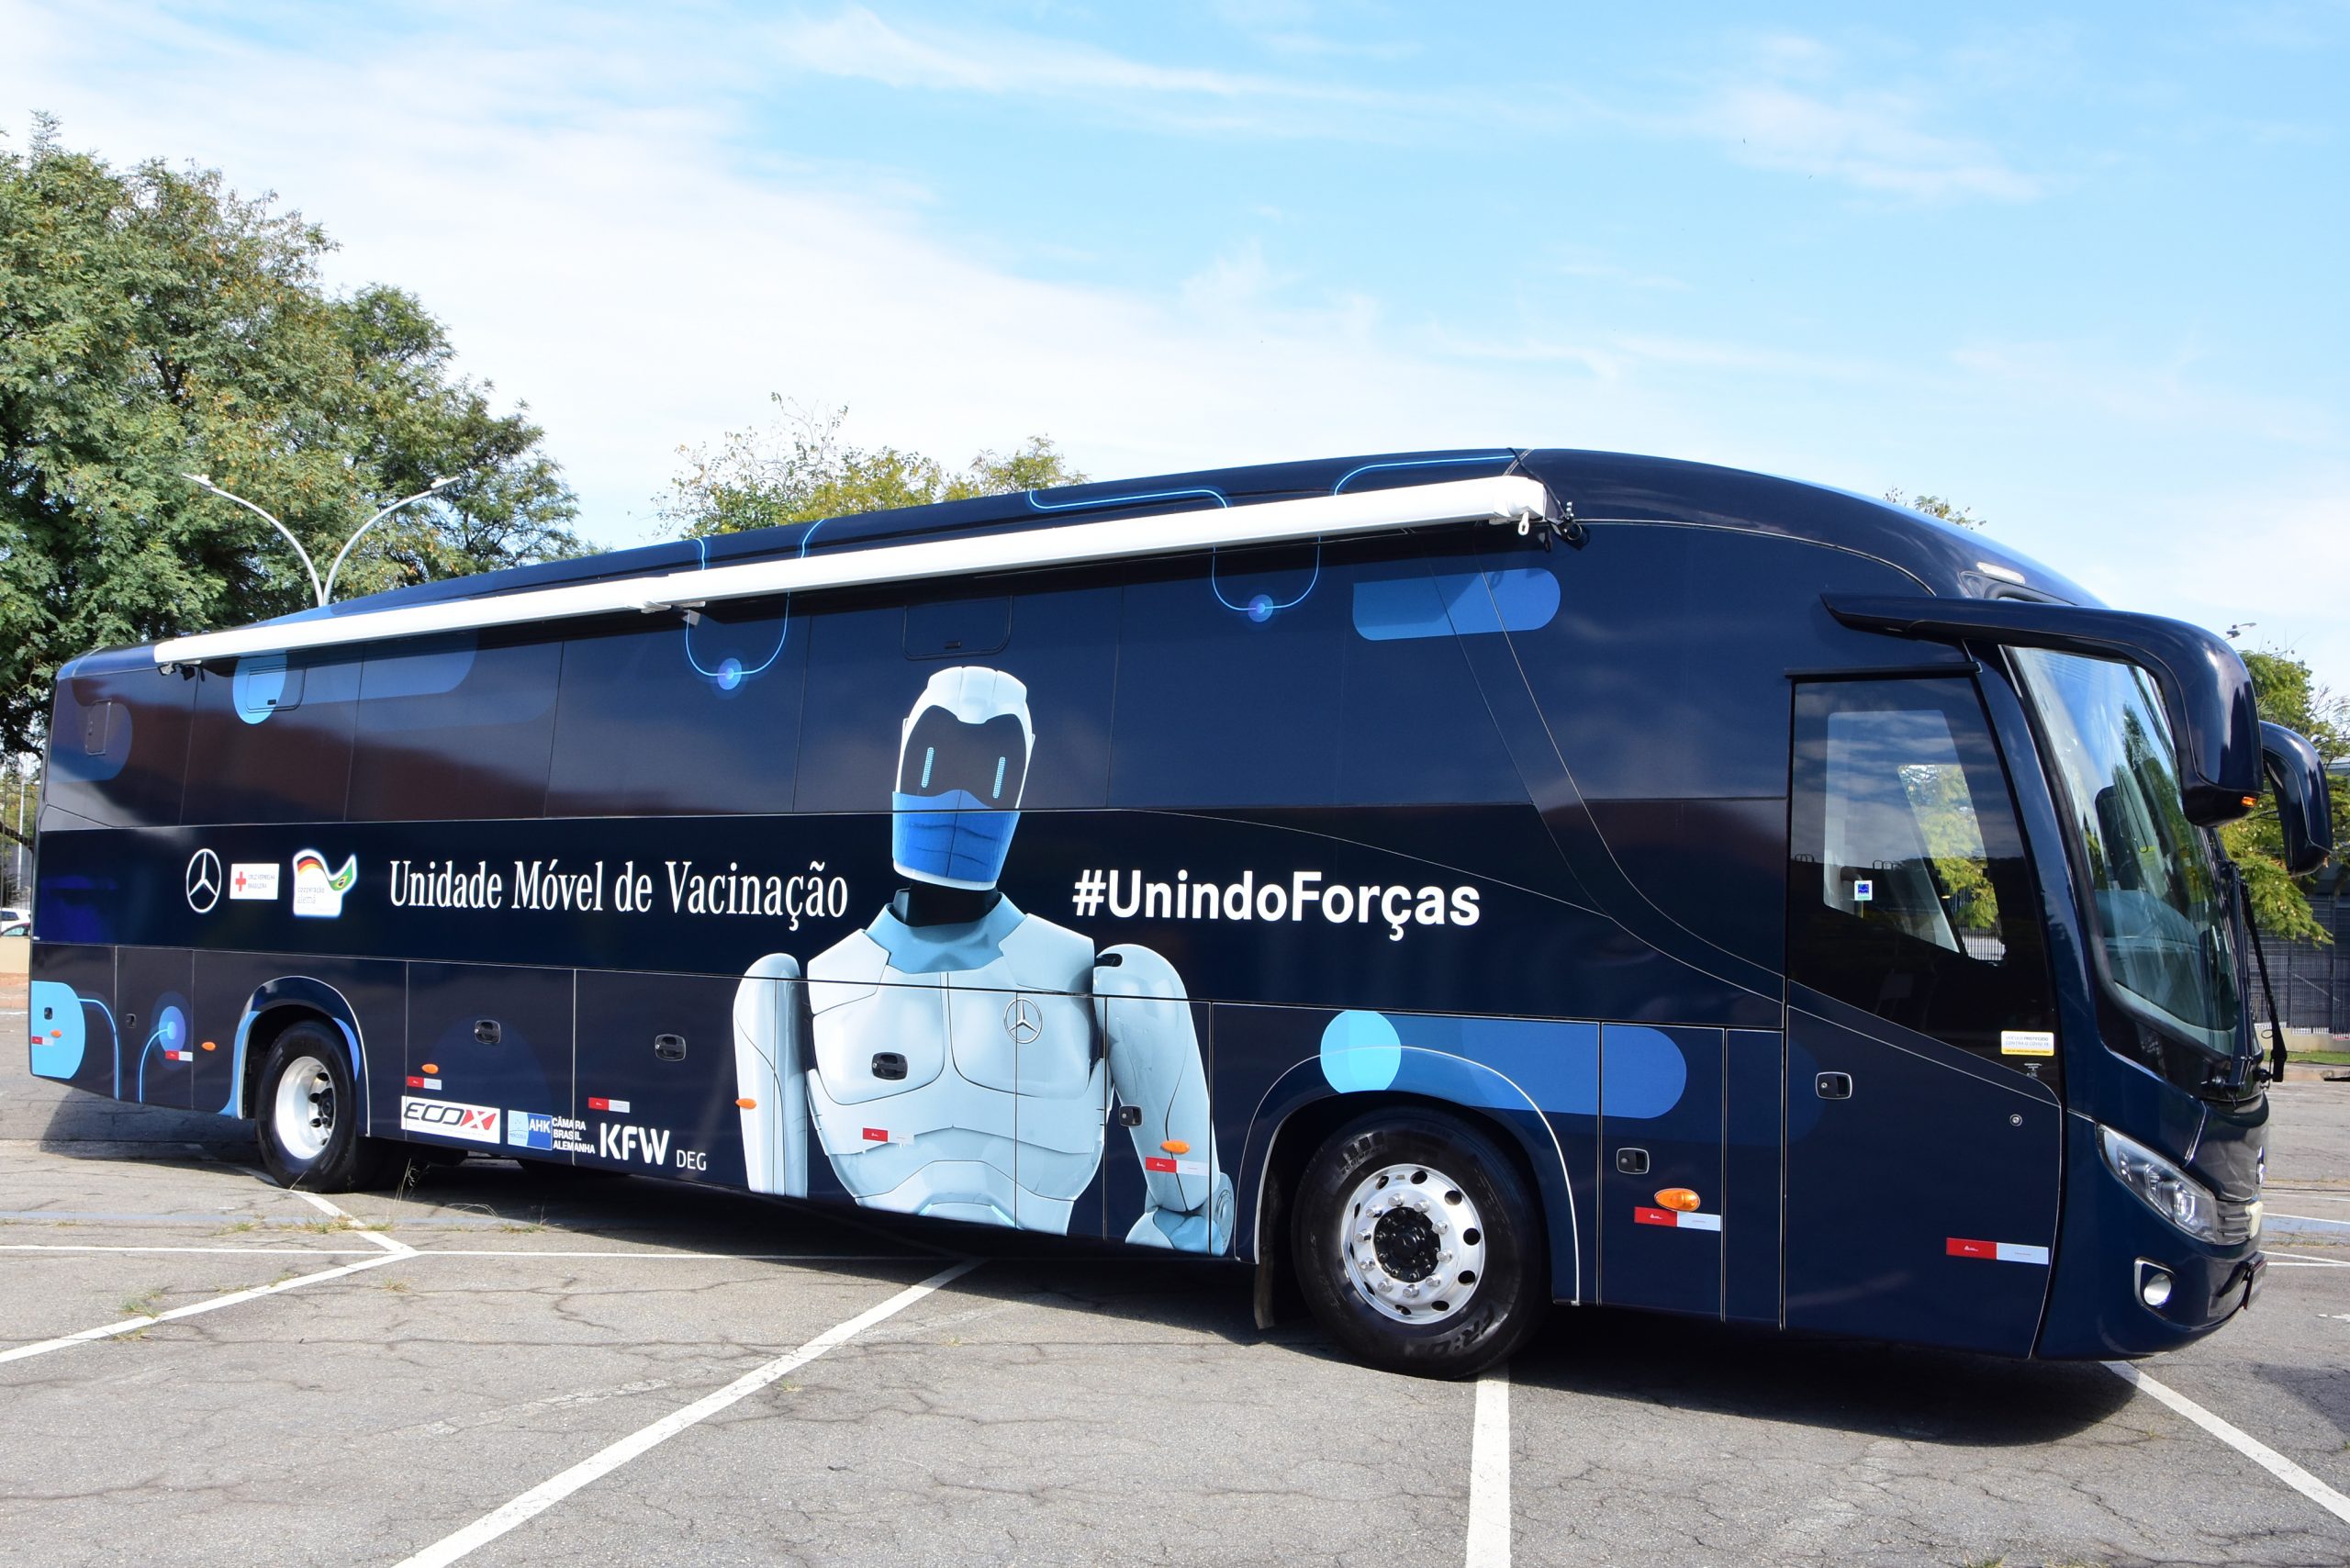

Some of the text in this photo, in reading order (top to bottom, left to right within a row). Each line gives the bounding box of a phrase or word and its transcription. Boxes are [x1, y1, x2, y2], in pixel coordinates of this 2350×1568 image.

[389, 858, 848, 931] Unidade Móvel de Vacinação
[1071, 868, 1481, 942] #UnindoForças
[404, 1102, 497, 1131] ECOX
[529, 1118, 551, 1134] AHK
[552, 1115, 587, 1131] CÂMARA
[553, 1128, 583, 1141] BRASIL
[553, 1139, 596, 1155] ALEMANHA
[599, 1122, 707, 1171] KFW DEG
